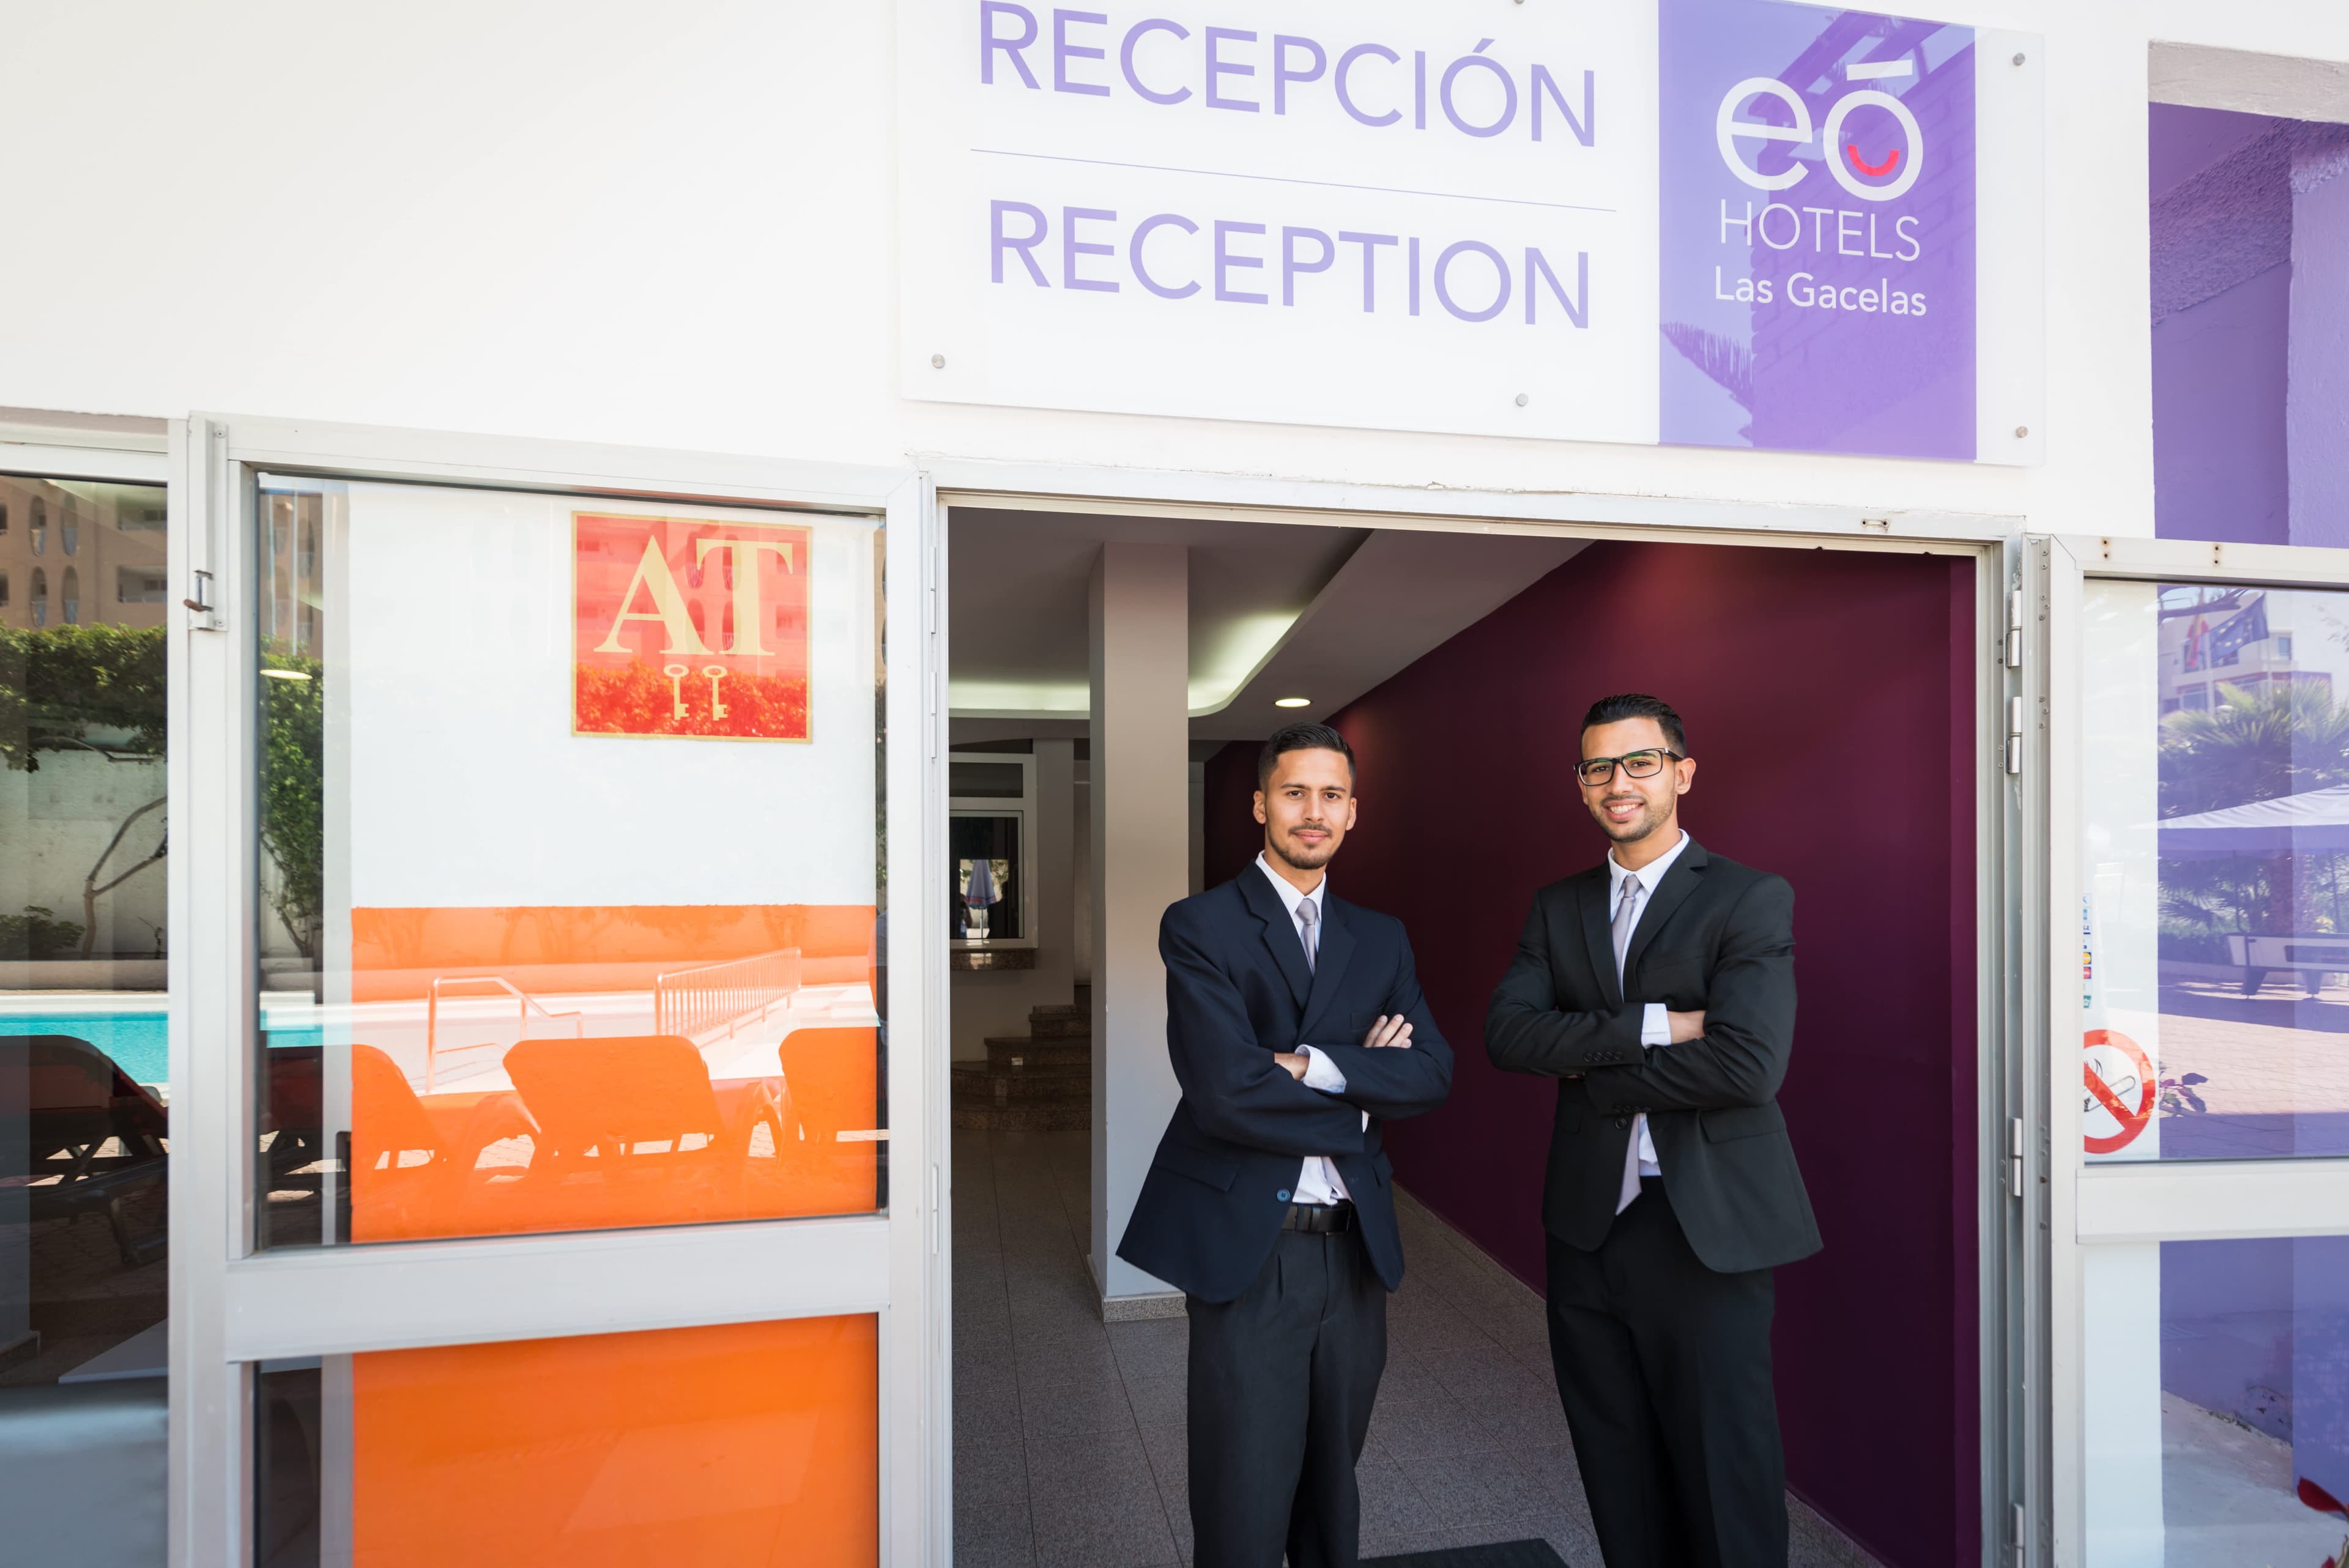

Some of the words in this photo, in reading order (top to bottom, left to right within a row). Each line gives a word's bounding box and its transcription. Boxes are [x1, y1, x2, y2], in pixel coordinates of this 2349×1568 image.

[981, 0, 1595, 147] RECEPCIÓN
[990, 200, 1589, 329] RECEPTION
[1721, 199, 1920, 261] HOTELS
[1715, 266, 1773, 303] Las
[1787, 272, 1926, 316] Gacelas
[593, 535, 793, 656] AT
